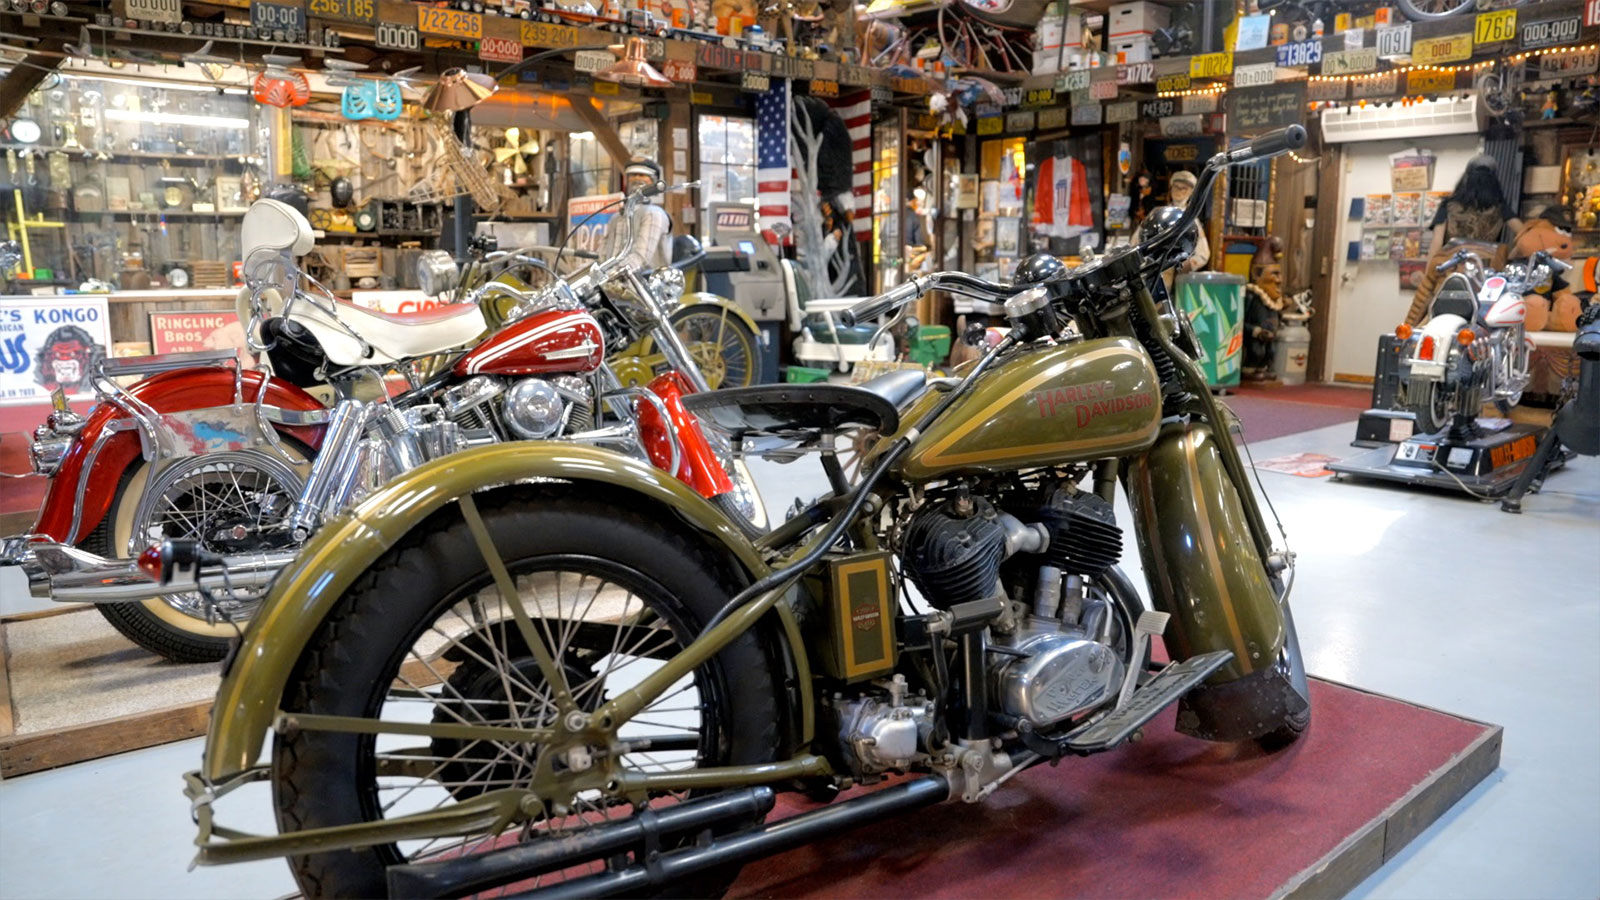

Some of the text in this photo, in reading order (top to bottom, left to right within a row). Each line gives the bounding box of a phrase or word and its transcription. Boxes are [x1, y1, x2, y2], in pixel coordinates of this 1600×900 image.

[378, 26, 418, 49] 0000
[1477, 15, 1514, 42] 1766
[1287, 40, 1322, 66] 13829
[1379, 28, 1409, 57] 1091
[1203, 55, 1230, 77] 10212
[33, 307, 98, 324] KONGO
[157, 317, 225, 330] RINGLING
[164, 331, 203, 342] BROS
[1075, 392, 1153, 429] DAVIDSON
